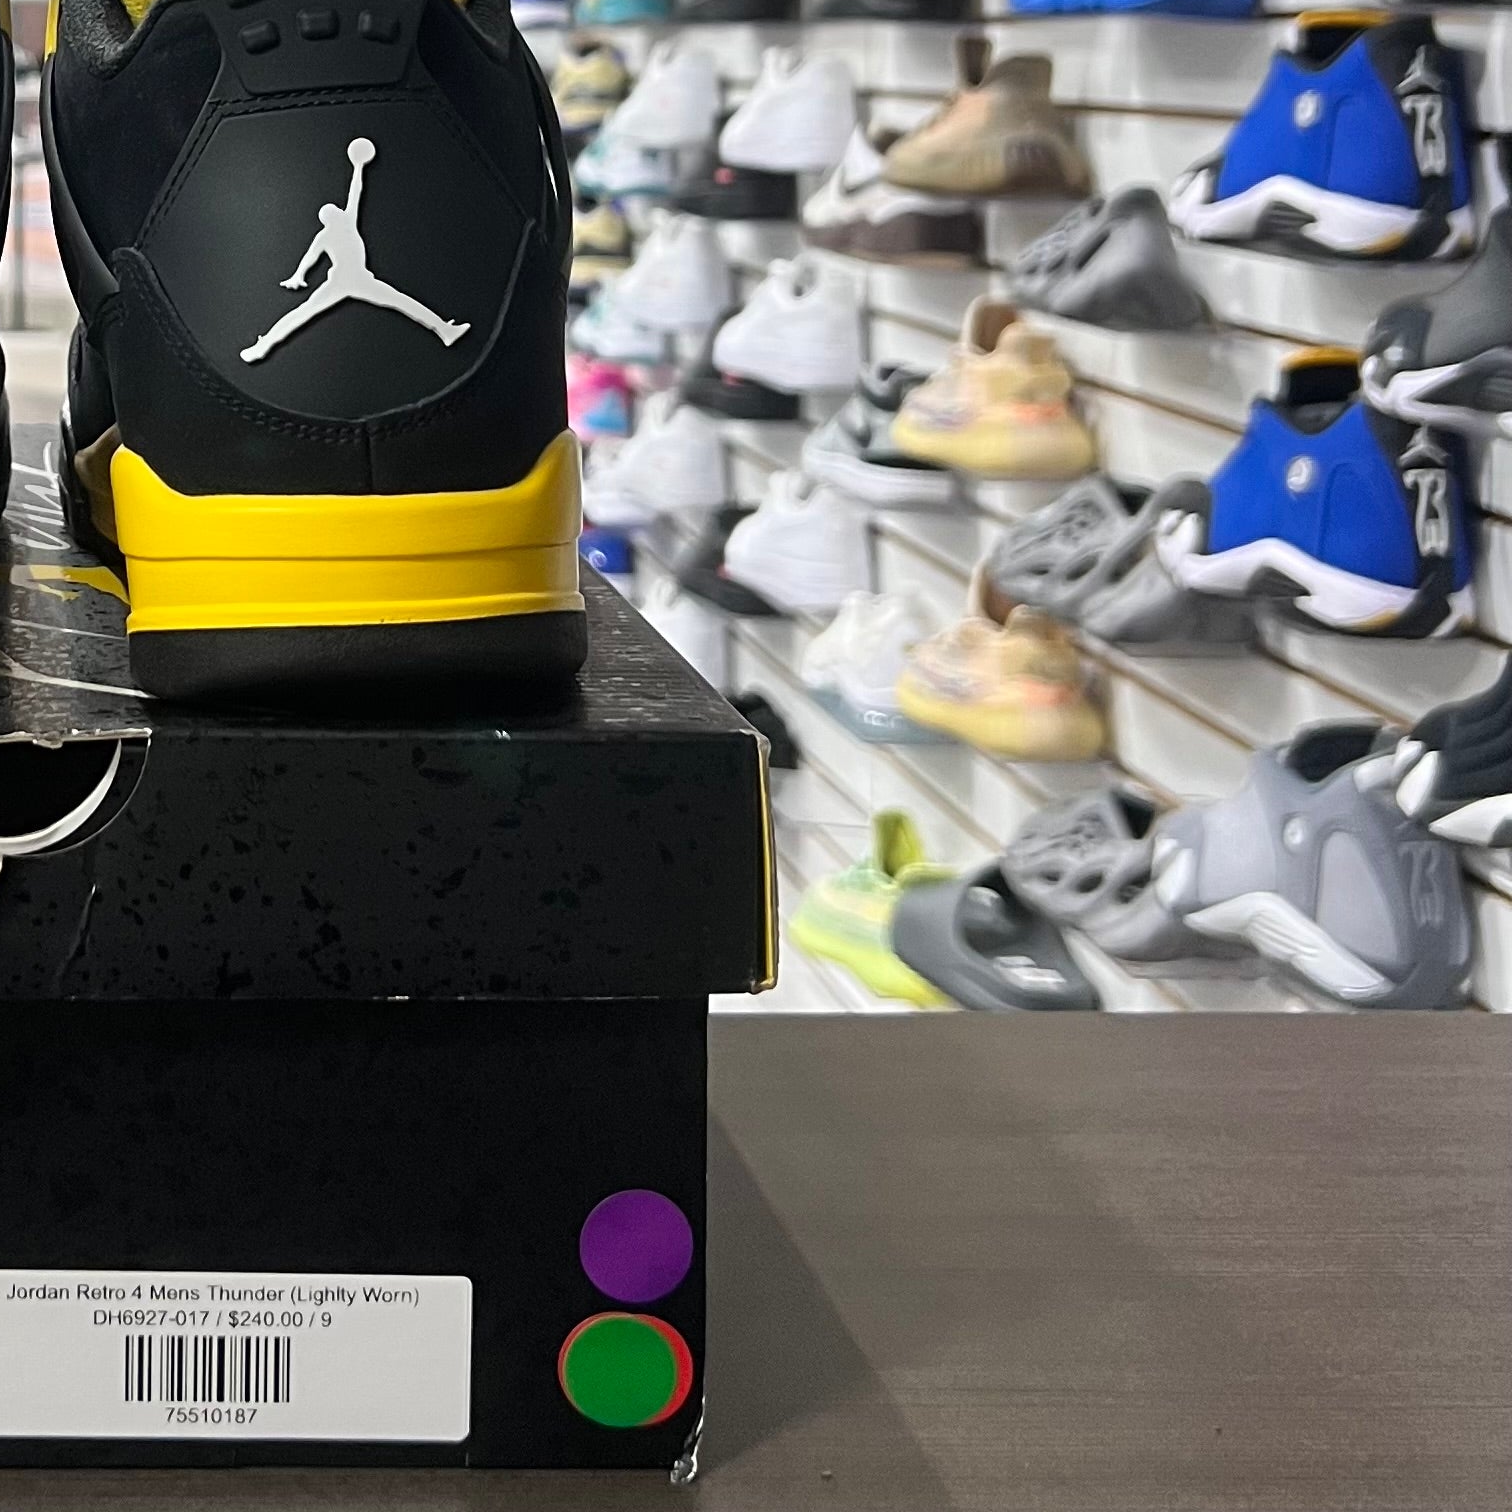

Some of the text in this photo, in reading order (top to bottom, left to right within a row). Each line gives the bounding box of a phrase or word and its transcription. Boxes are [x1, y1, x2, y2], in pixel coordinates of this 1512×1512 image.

[6, 1283, 70, 1300] Jordan
[76, 1284, 126, 1300] Retro
[131, 1285, 142, 1300] 4
[150, 1285, 200, 1301] Mens
[207, 1284, 286, 1303] Thunder
[362, 1286, 420, 1308] Worn)
[93, 1309, 333, 1328] DH6927-017 / $240.00 / 9
[164, 1406, 259, 1425] 75510187
